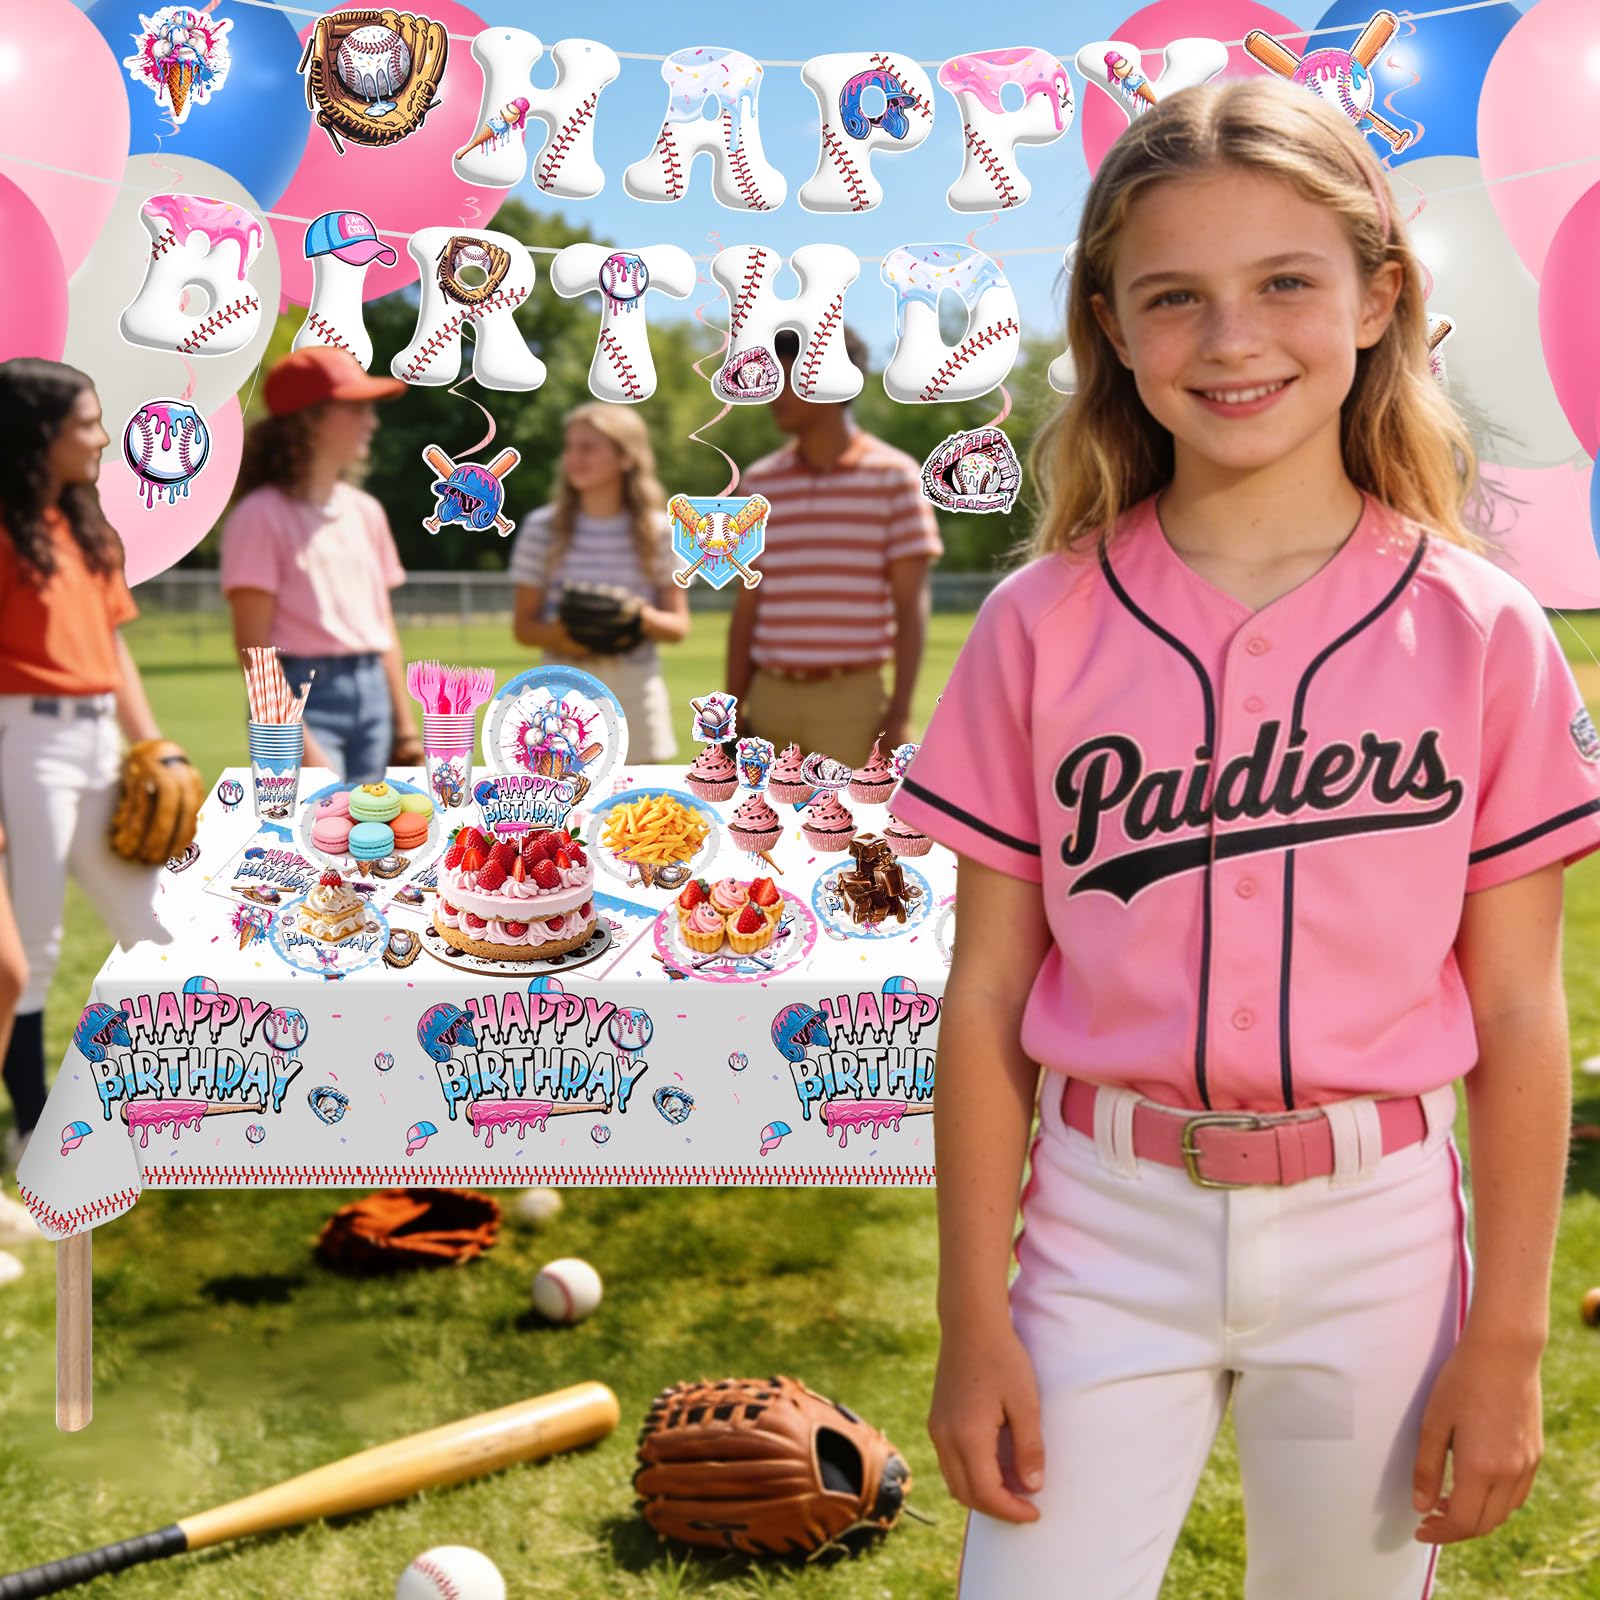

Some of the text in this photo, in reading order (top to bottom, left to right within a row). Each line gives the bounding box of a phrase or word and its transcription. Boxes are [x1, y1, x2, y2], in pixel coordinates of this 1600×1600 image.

[452, 26, 1229, 213] HAPPY
[119, 193, 1080, 404] BIRTHD
[262, 777, 296, 791] HAPPY
[494, 776, 559, 801] HAPPY
[1055, 719, 1463, 868] Paidiers
[481, 799, 572, 831] BIRTHDAY
[120, 991, 273, 1051] HAPPY
[465, 991, 618, 1051] HAPPY
[818, 991, 944, 1051] HAPP
[90, 1047, 304, 1121] BIRTHDAY
[435, 1047, 649, 1121] BIRTHDAY
